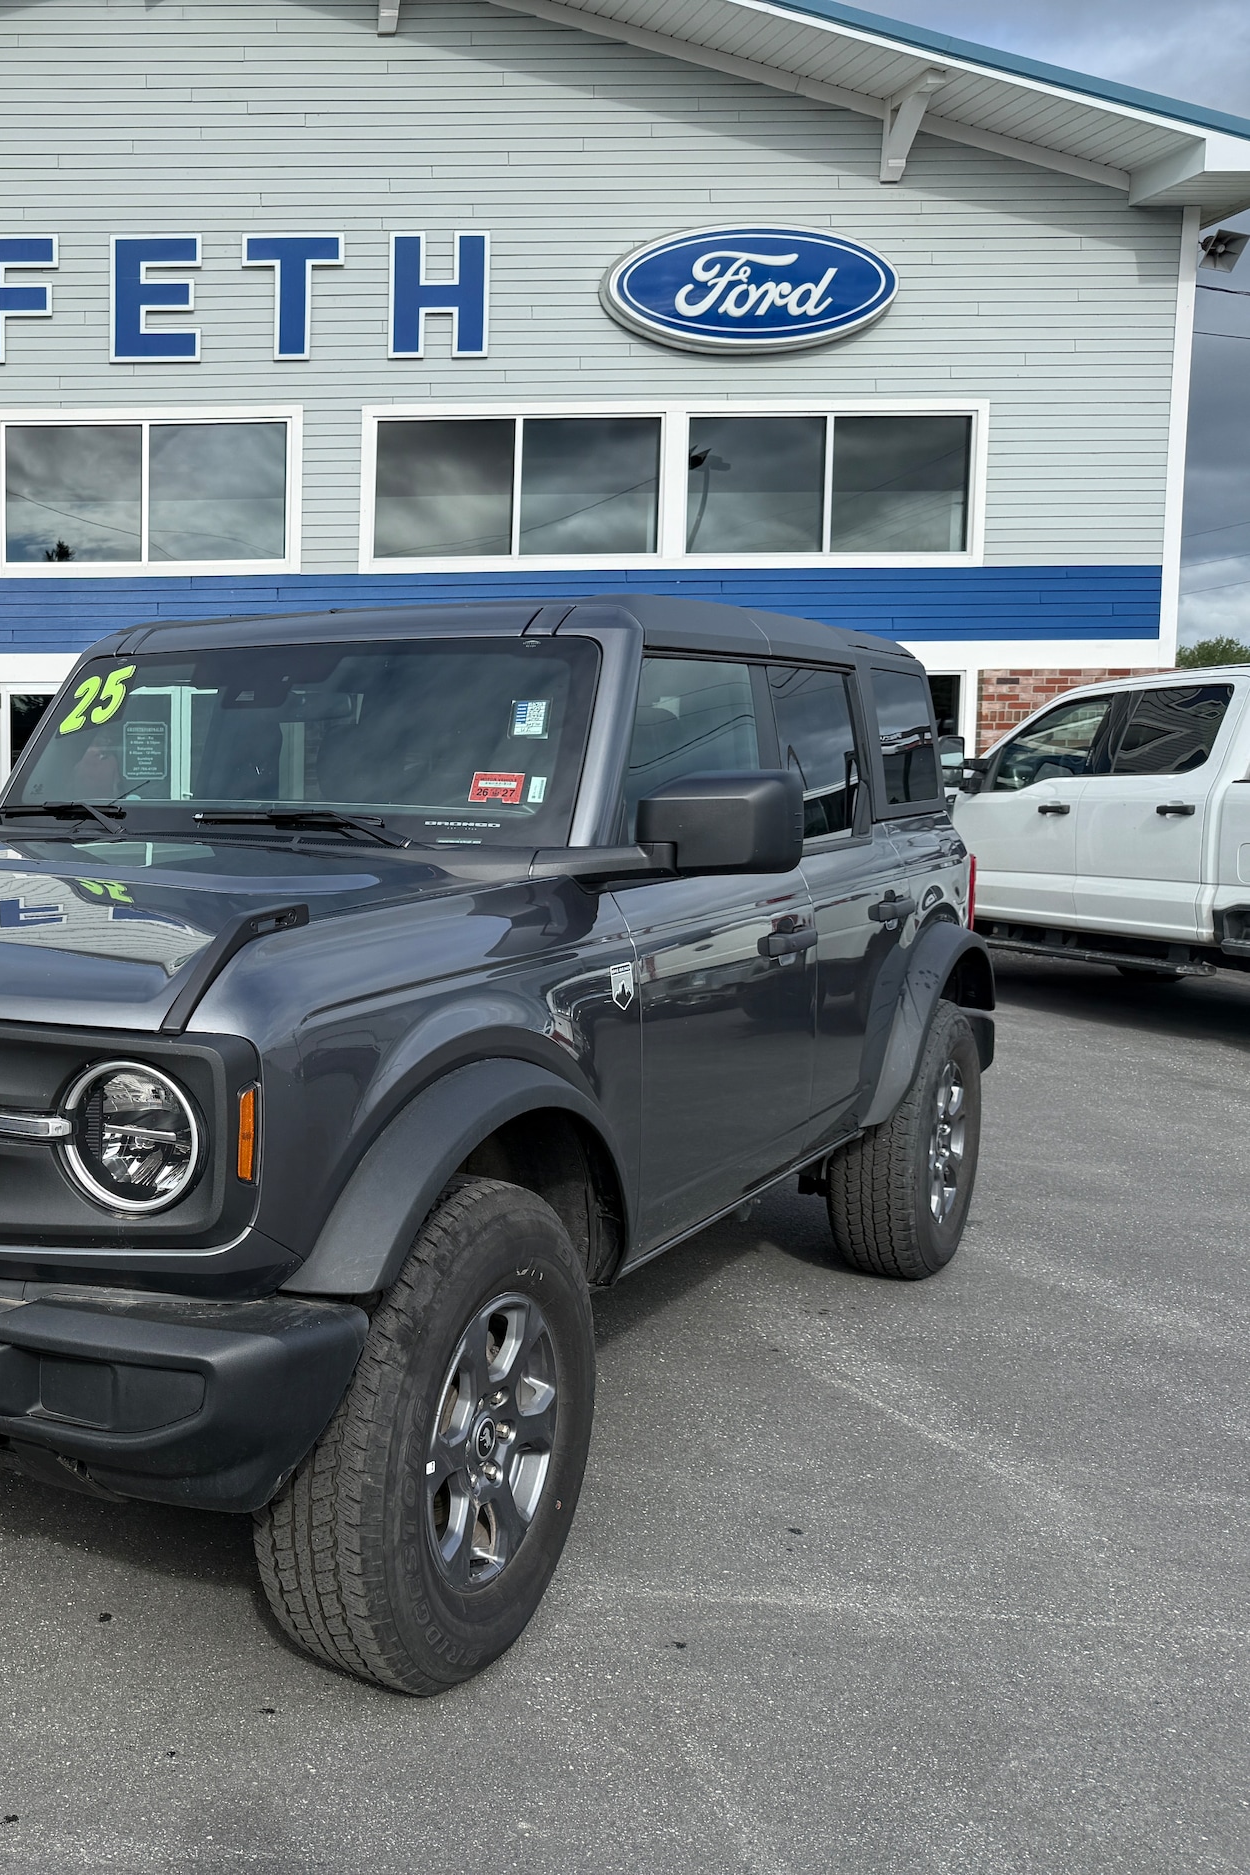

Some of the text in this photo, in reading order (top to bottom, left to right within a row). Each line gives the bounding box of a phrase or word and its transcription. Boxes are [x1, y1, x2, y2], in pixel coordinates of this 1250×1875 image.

[674, 250, 838, 317] Ford
[59, 665, 136, 736] 25
[476, 788, 516, 797] 26 27
